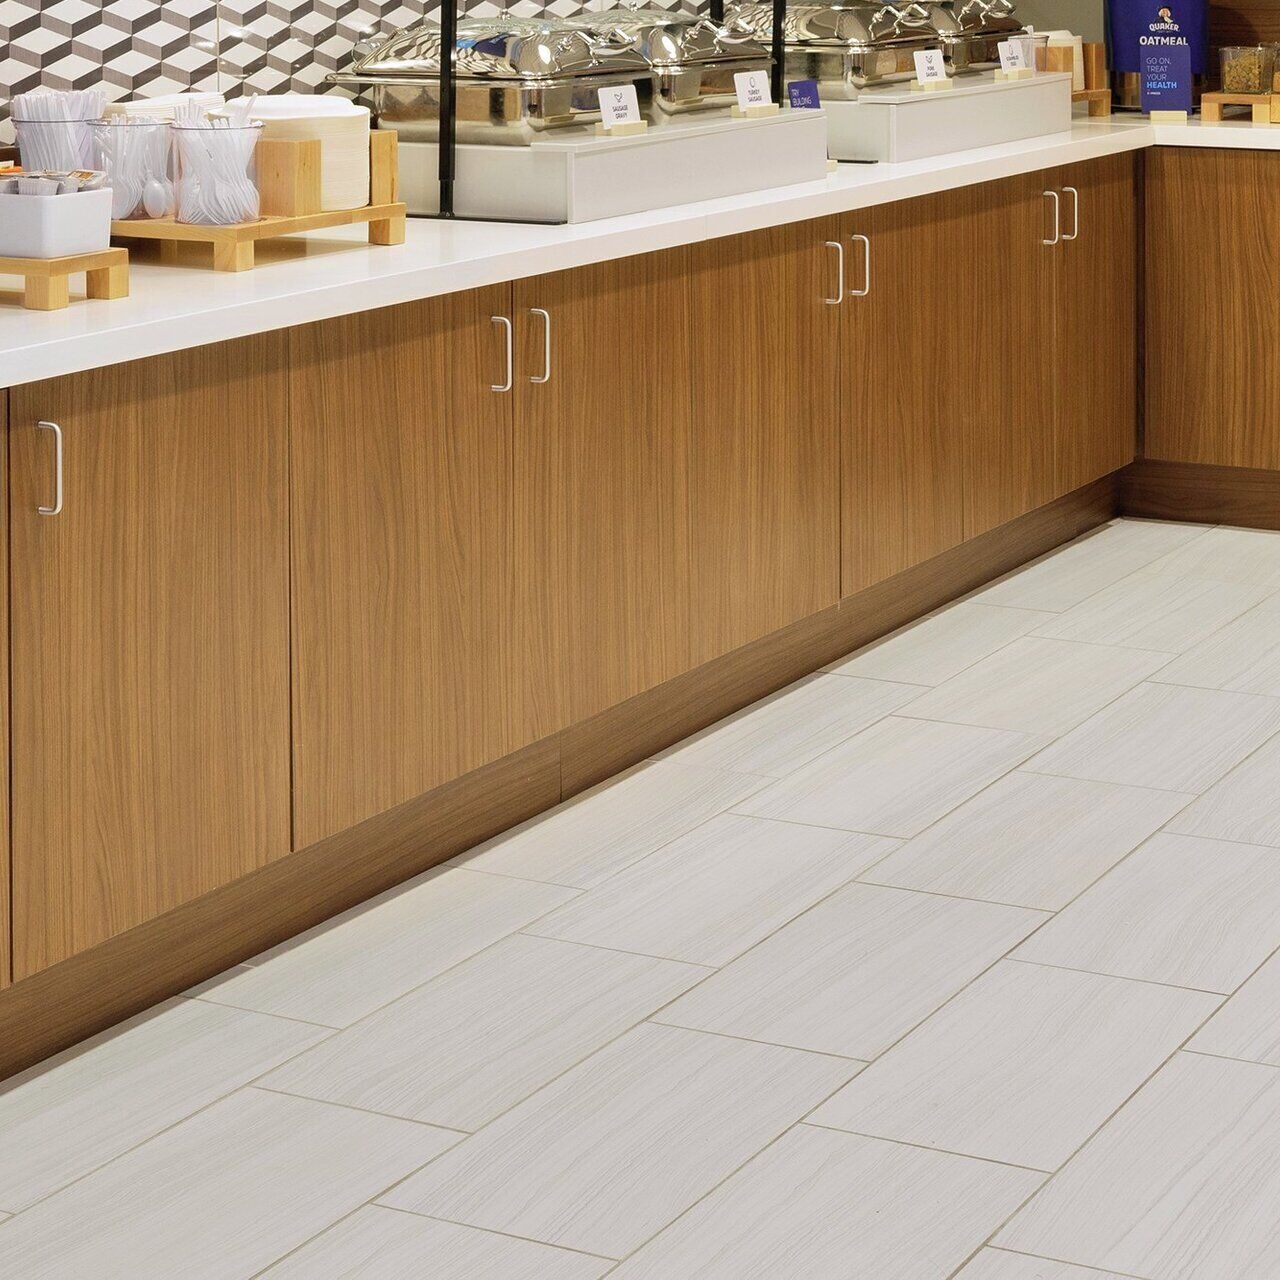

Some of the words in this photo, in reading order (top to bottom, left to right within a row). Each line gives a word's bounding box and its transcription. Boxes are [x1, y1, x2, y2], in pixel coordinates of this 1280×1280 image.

[1149, 23, 1180, 31] QUAKER
[1140, 36, 1189, 46] OATMEAL
[1146, 57, 1157, 65] GO
[1146, 81, 1177, 89] HEALTH
